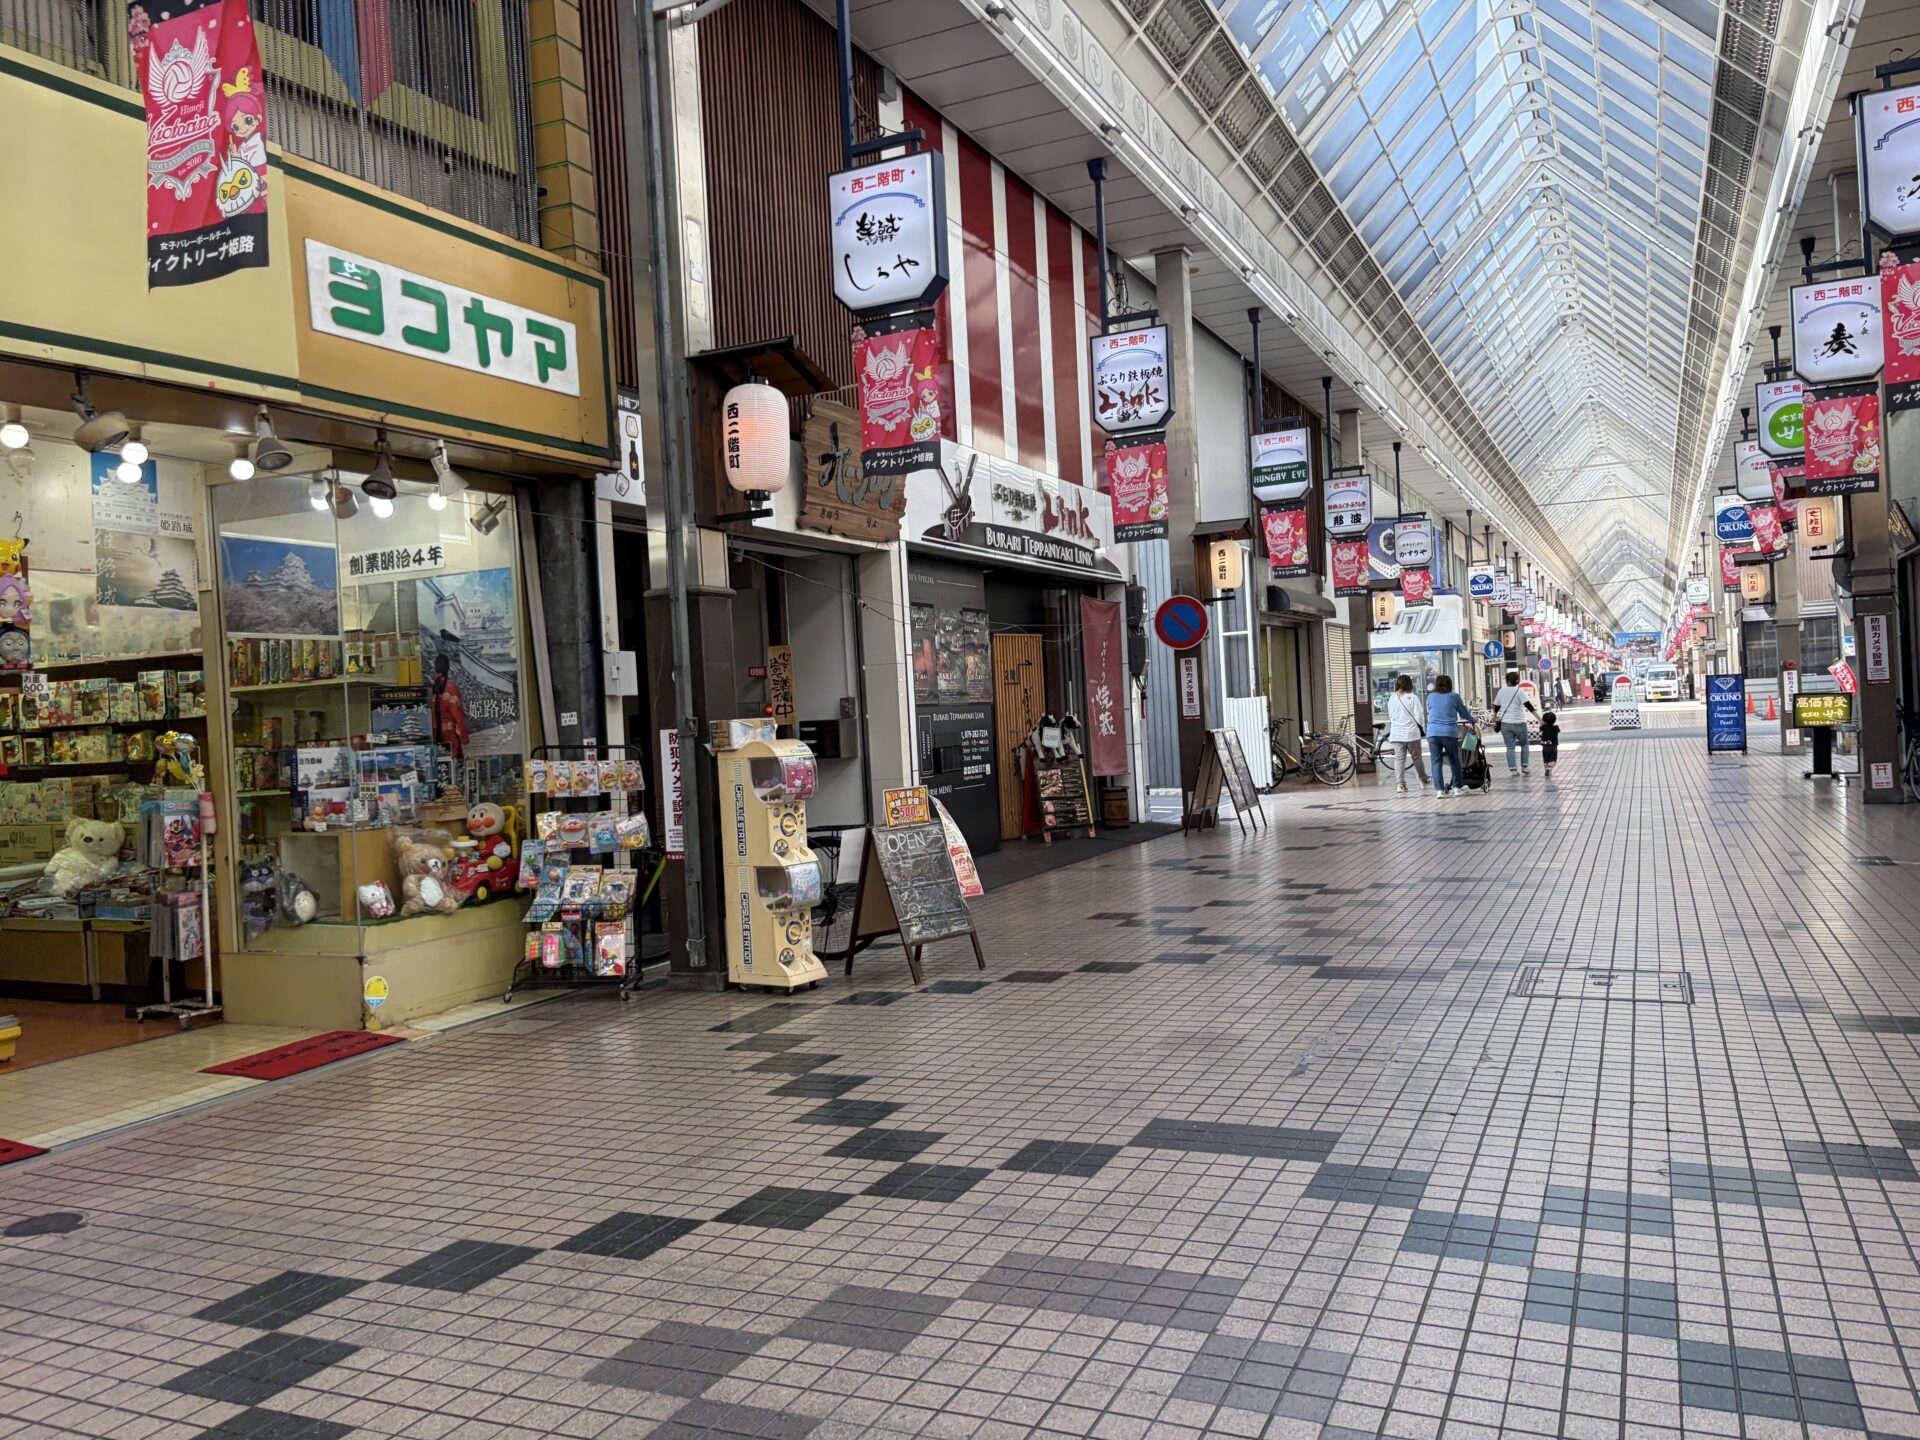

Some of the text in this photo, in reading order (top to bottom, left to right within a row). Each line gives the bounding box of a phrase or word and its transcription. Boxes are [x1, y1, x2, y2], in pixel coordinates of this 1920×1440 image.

[1897, 97, 1920, 113] 西
[851, 169, 905, 193] 西二階町
[160, 227, 231, 250] 女子バレーボールチーム
[1814, 285, 1862, 301] 西二階町
[329, 255, 567, 384] ヨコヤマ
[1109, 334, 1148, 350] 西二階町
[1098, 366, 1164, 386] ぶらり鉄板焼
[1098, 383, 1164, 414] Link
[727, 403, 741, 470] 西二階町
[1264, 436, 1293, 446] 西二階町
[865, 452, 934, 470] ヴィクトリーナ姫路
[1254, 469, 1306, 484] HUNGRY EYE
[1334, 481, 1358, 490] 西二階町
[1811, 480, 1875, 494] ヴィクトリーナ姫路
[1037, 479, 1094, 540] Link
[160, 519, 194, 534] 姫路城
[1333, 512, 1362, 526] 那波
[1719, 524, 1754, 532] OKUNO
[986, 526, 1094, 566] BURARI TEPPANYAKI LINK
[1399, 548, 1428, 558] かすりや
[350, 546, 443, 576] 創業明治4年
[1218, 549, 1227, 580] 西二階町
[1870, 617, 1882, 667] 防犯カメラ設置
[24, 683, 44, 692] 600
[1184, 659, 1194, 704] 防犯カメラ設置
[1710, 694, 1742, 702] OKUNO
[1796, 696, 1848, 708] 高価買受
[468, 699, 516, 720] 姫路城
[932, 713, 949, 722] BURARI
[950, 712, 974, 720] TEPPANYAKI
[938, 784, 952, 794] MENU
[736, 785, 746, 856] CAPSULE STATION
[900, 806, 916, 818] 500
[887, 832, 926, 852] OPEN
[741, 893, 752, 964] CAPSULE STATION
